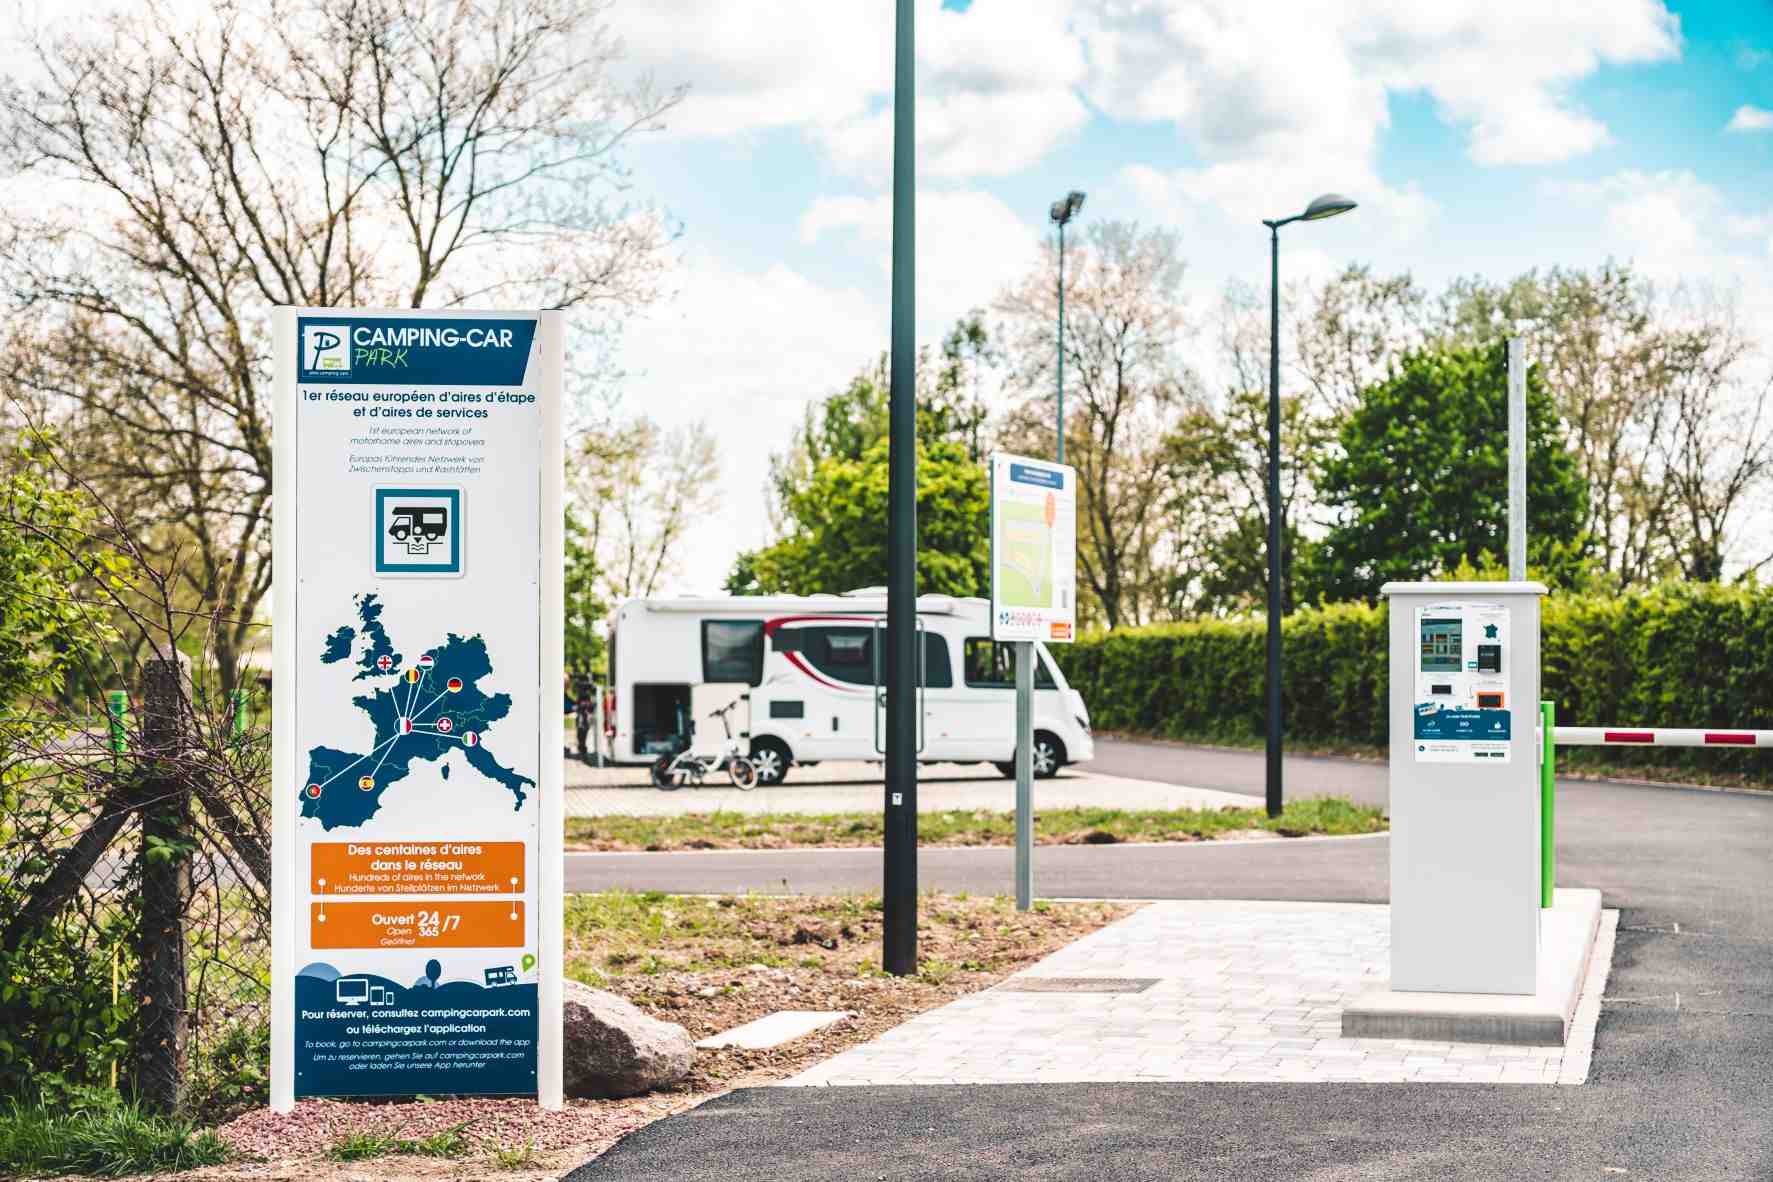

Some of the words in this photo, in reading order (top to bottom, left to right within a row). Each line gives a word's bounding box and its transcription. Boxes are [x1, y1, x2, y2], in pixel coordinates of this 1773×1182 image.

[353, 327, 512, 348] CAMPING-CAR
[354, 347, 408, 369] PARK
[302, 389, 322, 401] 1er
[325, 388, 369, 402] réseau
[372, 390, 436, 404] européen
[439, 391, 482, 402] d'aires
[485, 391, 536, 405] d'étape
[353, 406, 366, 417] et
[369, 406, 412, 417] d'aires
[415, 407, 433, 418] de
[436, 407, 489, 418] services
[415, 465, 433, 473] und
[348, 844, 372, 856] Des
[374, 844, 437, 856] centaines
[440, 843, 482, 855] d'aires
[370, 859, 402, 871] dans
[405, 860, 417, 870] le
[420, 858, 463, 871] réseau
[349, 873, 390, 881] Hundreds
[392, 873, 401, 881] of
[402, 873, 423, 881] aires
[425, 873, 433, 881] in
[435, 872, 449, 881] the
[451, 872, 486, 881] network
[335, 884, 375, 893] Hunderte
[378, 885, 394, 893] von
[396, 884, 445, 892] Stellplätzen
[447, 884, 458, 892] im
[460, 883, 499, 892] Netzwerk
[371, 913, 415, 926] Ouvert
[386, 927, 412, 937] Open
[418, 927, 440, 936] 365
[302, 1010, 324, 1019] Pour
[326, 1009, 369, 1020] réserver,
[371, 1009, 419, 1018] consultez
[421, 1008, 531, 1019] campingcarpark.com
[346, 1026, 360, 1034] ou
[362, 1024, 422, 1035] téléchargez
[424, 1024, 486, 1034] l'application
[339, 1041, 351, 1049] go
[362, 1039, 447, 1048] campingcarpark.com
[313, 1053, 326, 1061] Um
[384, 1053, 410, 1062] gehen
[424, 1052, 439, 1060] auf
[439, 1052, 525, 1060] campingcarpark.com
